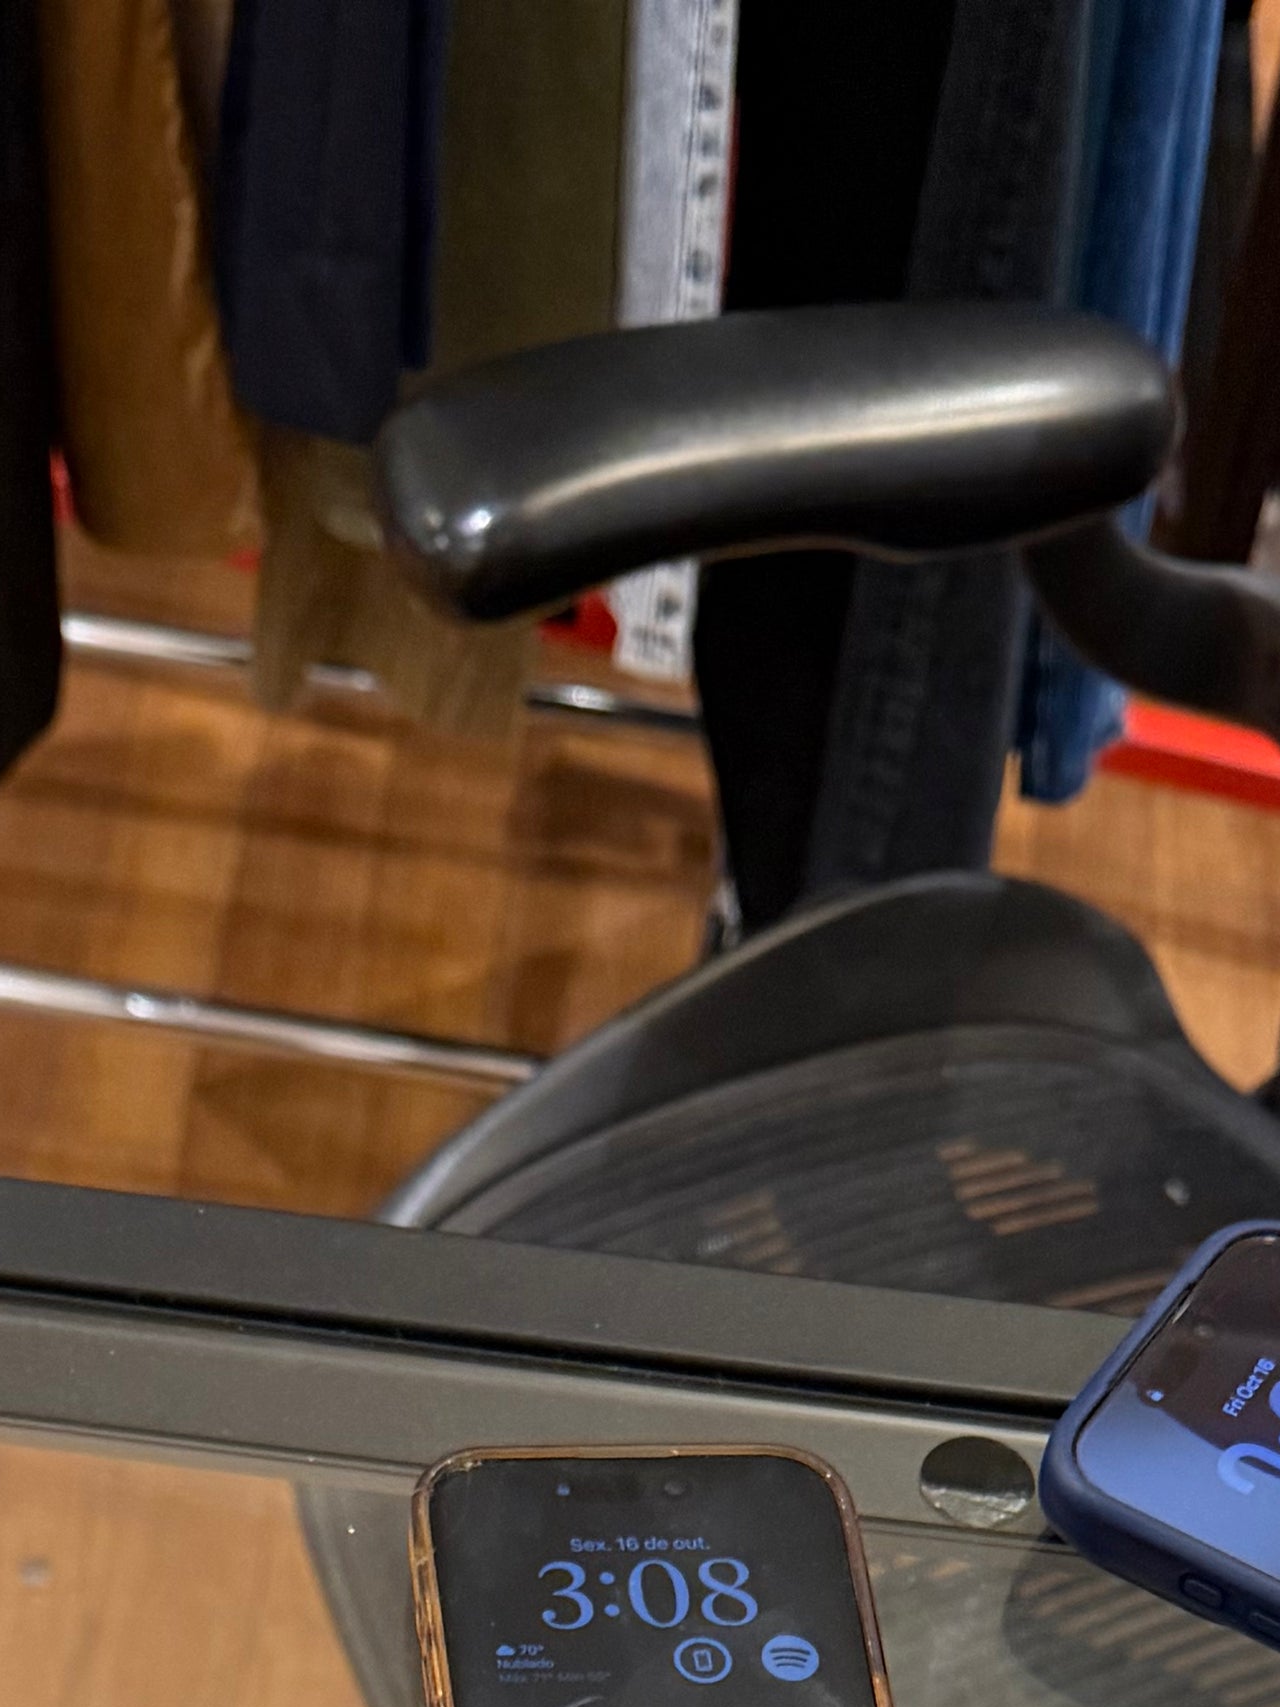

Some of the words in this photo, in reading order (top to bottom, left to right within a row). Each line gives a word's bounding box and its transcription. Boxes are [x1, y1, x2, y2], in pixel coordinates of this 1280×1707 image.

[1222, 1397, 1245, 1417] Fri
[1236, 1374, 1264, 1399] Oct
[1253, 1358, 1276, 1375] 16
[570, 1537, 612, 1552] Sex.
[616, 1537, 639, 1551] 16
[644, 1537, 668, 1550] de
[673, 1537, 711, 1550] out.
[538, 1557, 758, 1629] 3:08
